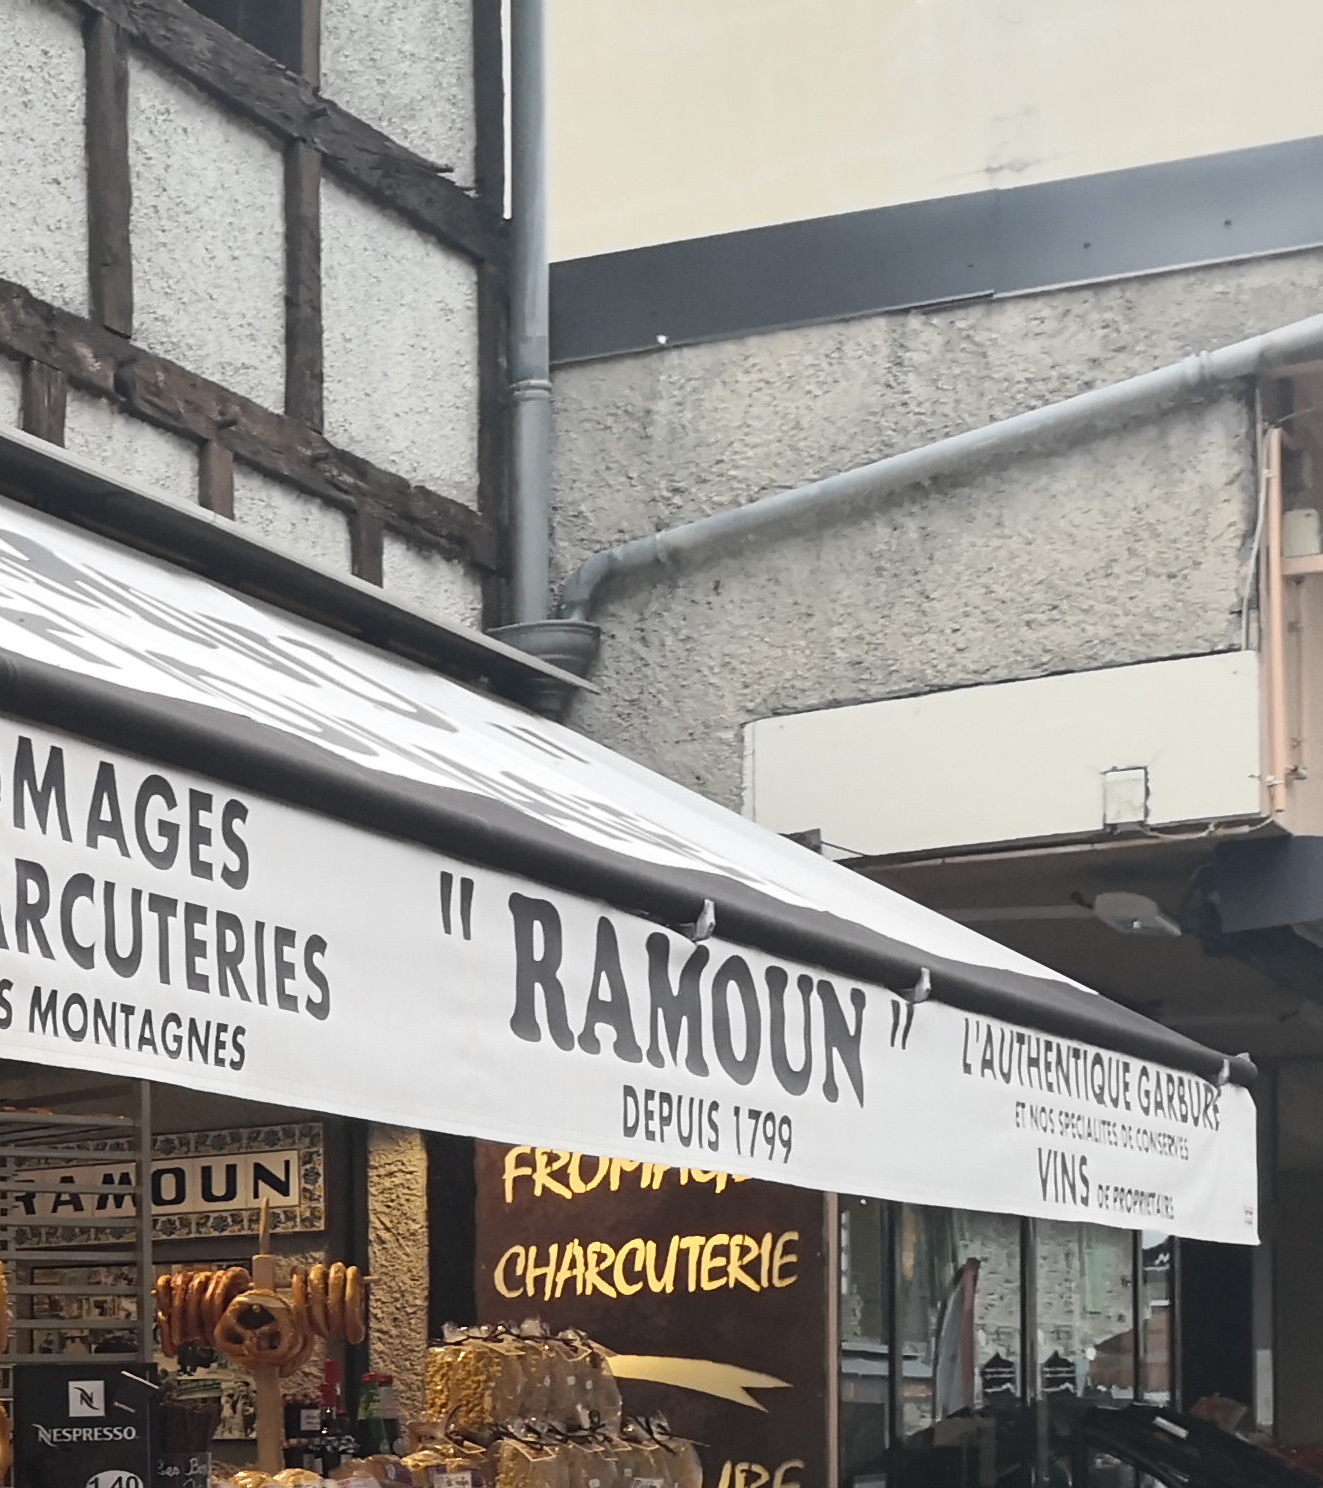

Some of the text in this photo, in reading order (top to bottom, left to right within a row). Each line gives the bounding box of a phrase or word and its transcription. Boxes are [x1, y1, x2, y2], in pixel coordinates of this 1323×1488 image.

[29, 988, 248, 1071] MONTAGNES
[508, 891, 867, 1108] RAMOUN
[962, 1017, 1221, 1132] L'AUTHENTIQUE GARBURE
[622, 1083, 794, 1165] DEPUIS 1799
[1015, 1101, 1026, 1129] ET
[1030, 1104, 1055, 1135] NOS
[1121, 1124, 1134, 1150] DE
[1136, 1128, 1190, 1161] CONSERVES
[14, 1158, 292, 1216] RAMOUN
[502, 1146, 753, 1203] FROMAG
[1038, 1147, 1090, 1207] VINS
[1097, 1184, 1110, 1209] DE
[493, 1230, 799, 1301] CHARCUTERIE
[31, 1423, 139, 1447] NESPRESSO
